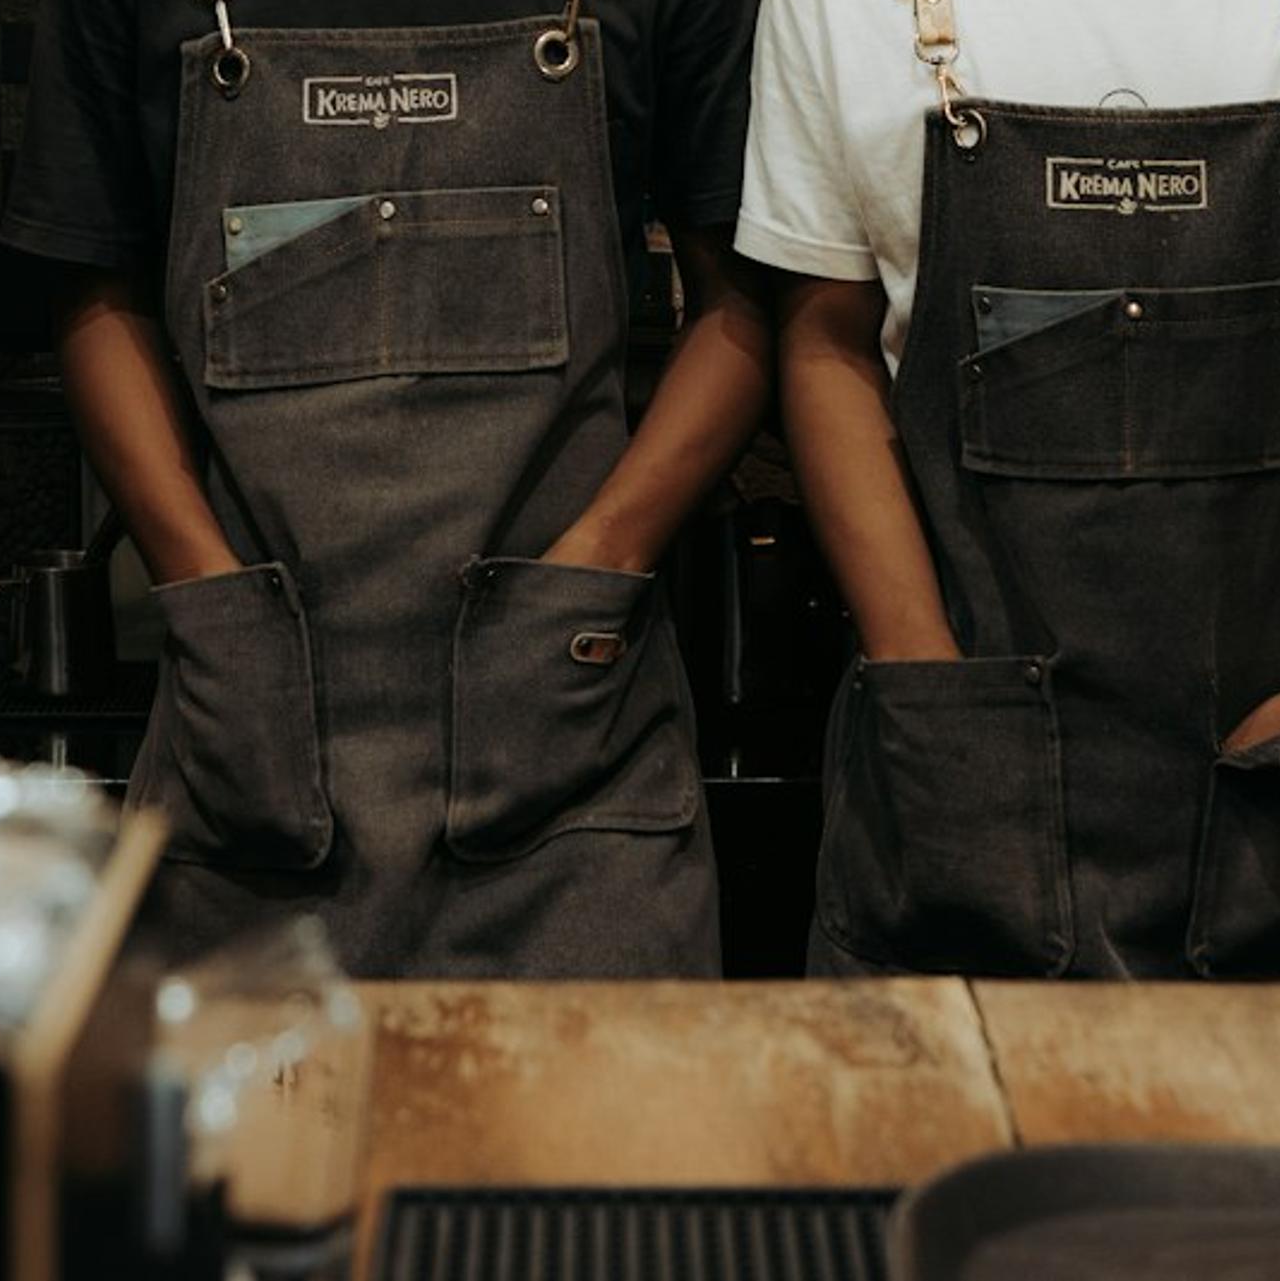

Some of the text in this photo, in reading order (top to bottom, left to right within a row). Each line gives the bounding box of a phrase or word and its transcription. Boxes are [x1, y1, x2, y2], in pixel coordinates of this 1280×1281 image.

[317, 86, 449, 116] KREMA NERO
[1060, 171, 1199, 200] KREMA NERO
